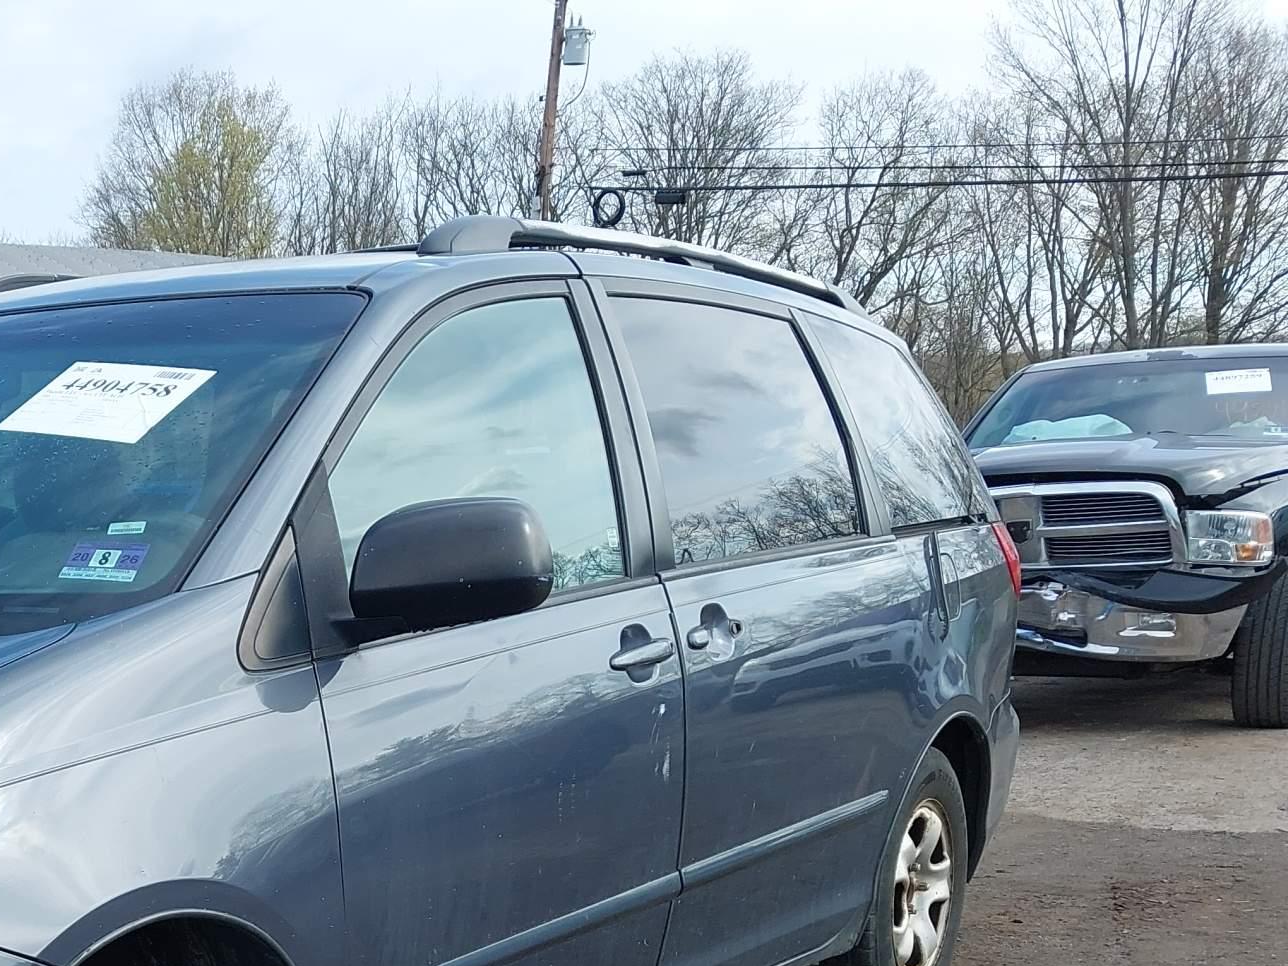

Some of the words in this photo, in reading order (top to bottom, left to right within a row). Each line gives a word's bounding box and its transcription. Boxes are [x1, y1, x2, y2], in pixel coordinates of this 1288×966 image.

[61, 377, 178, 398] 44904758
[71, 552, 89, 562] 20
[98, 551, 111, 565] 8
